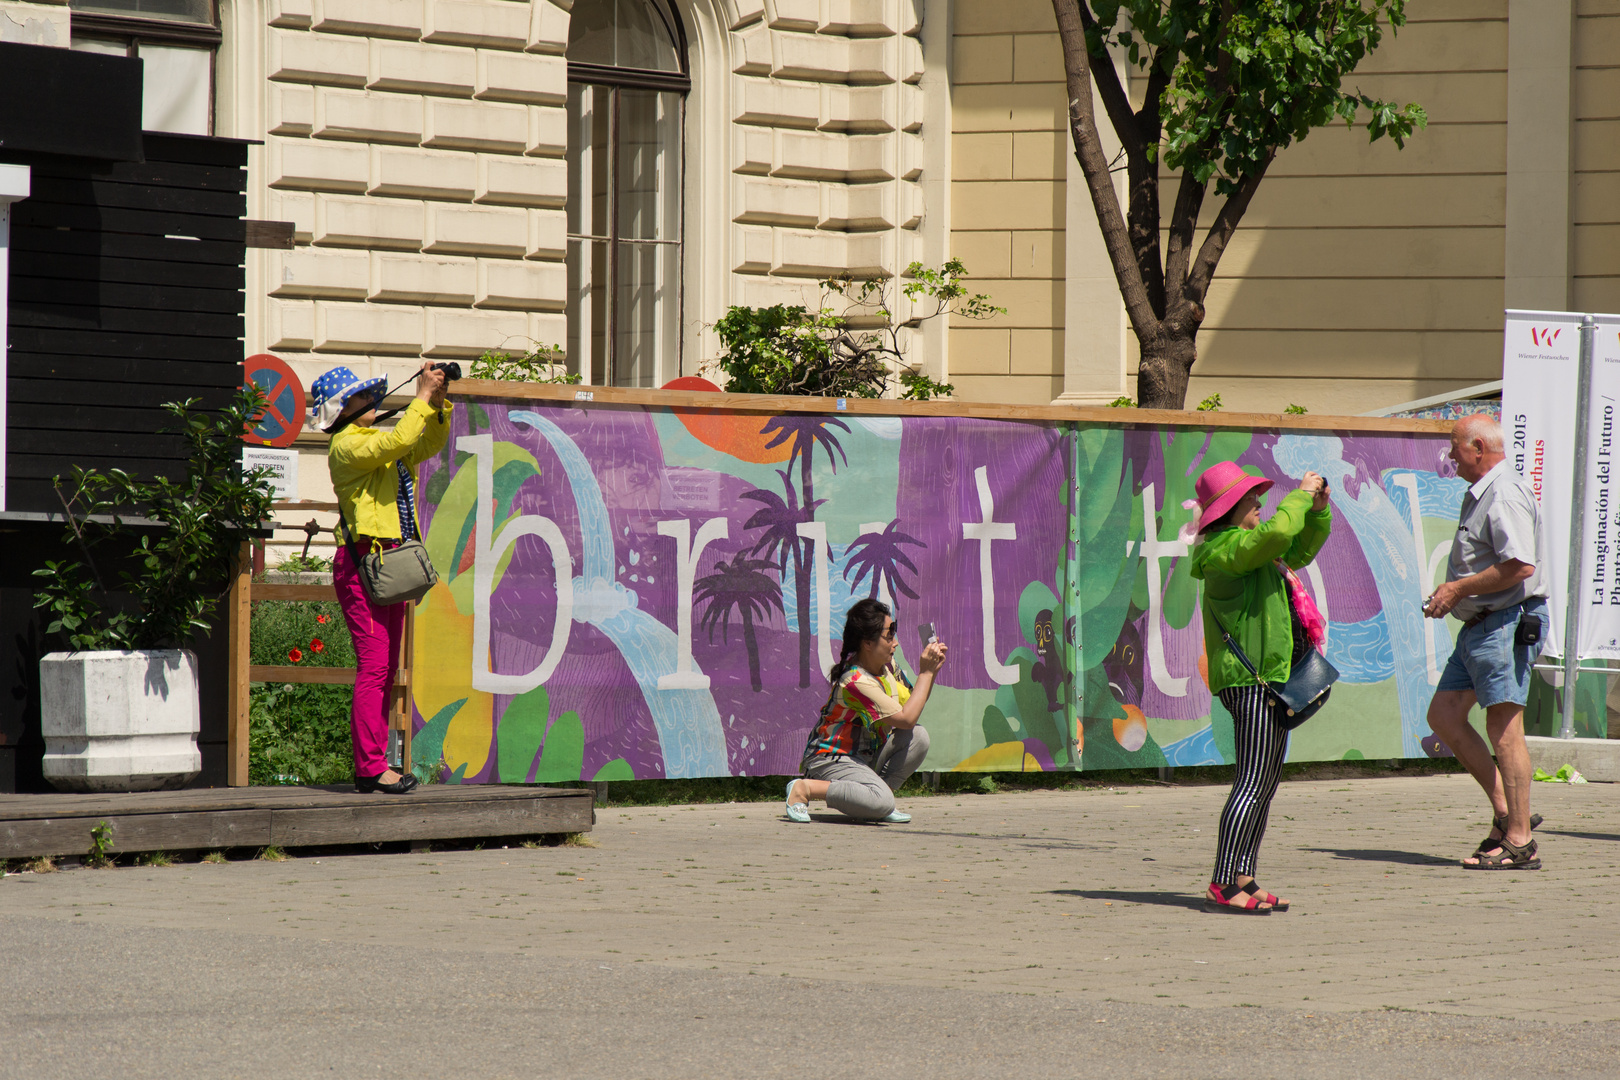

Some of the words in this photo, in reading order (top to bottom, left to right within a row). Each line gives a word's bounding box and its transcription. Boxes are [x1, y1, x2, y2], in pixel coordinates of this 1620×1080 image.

[1538, 353, 1570, 361] Festwochen
[1513, 414, 1527, 449] 2015
[1598, 405, 1614, 457] Futuro
[1596, 461, 1610, 484] del
[1592, 488, 1610, 584] Imaginación
[1591, 587, 1604, 606] La
